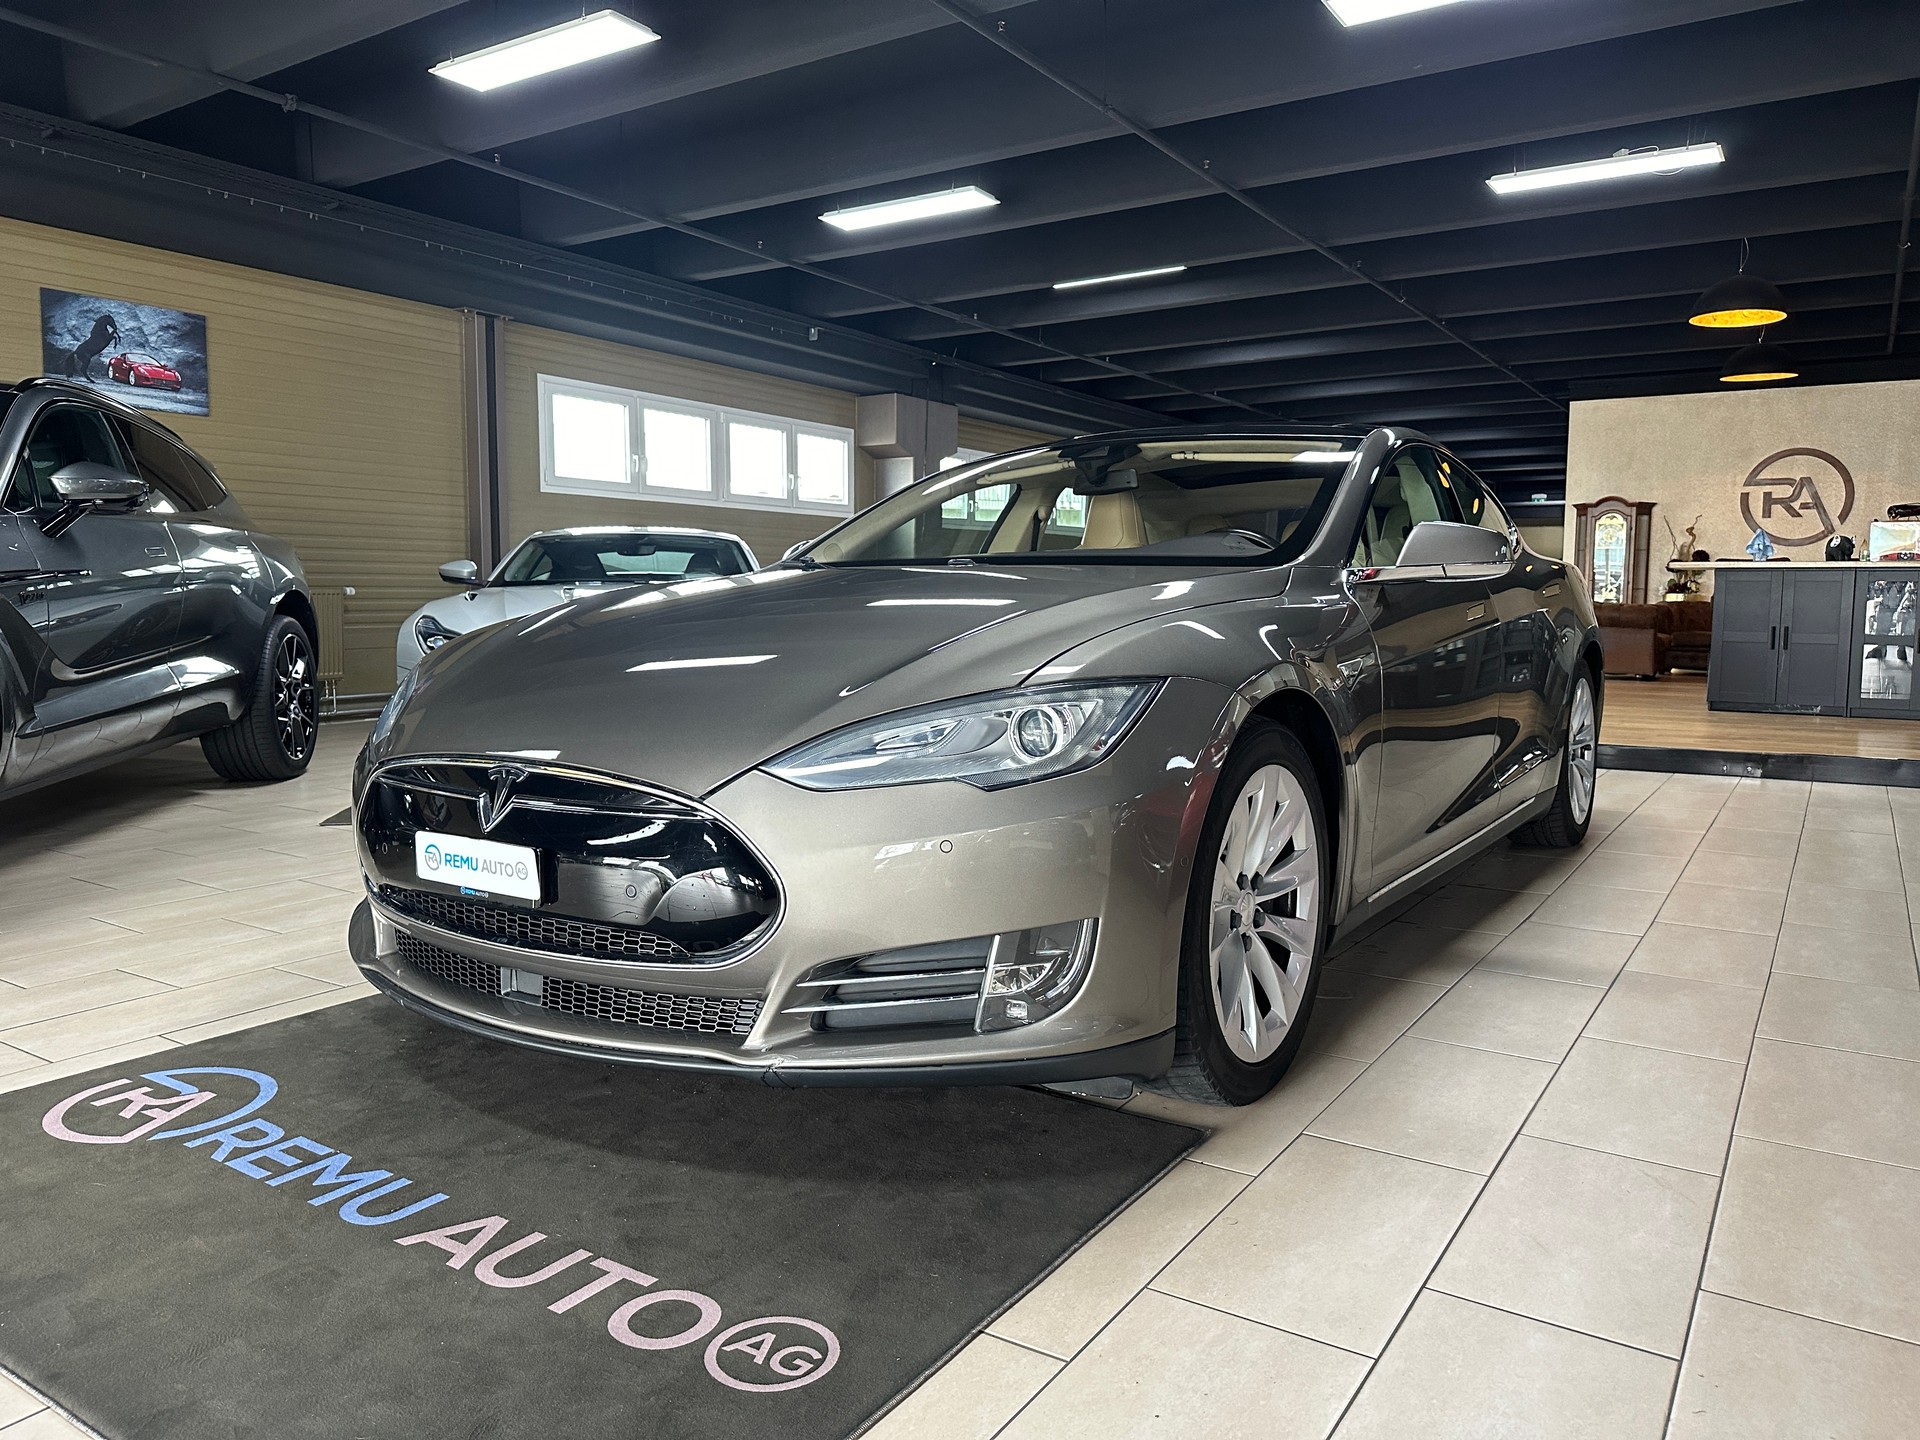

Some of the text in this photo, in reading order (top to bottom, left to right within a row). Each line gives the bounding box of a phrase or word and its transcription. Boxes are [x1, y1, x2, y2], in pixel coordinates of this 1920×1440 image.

[444, 852, 479, 871] REMU
[481, 859, 514, 877] AUTO
[183, 1117, 450, 1226] REMU
[393, 1215, 722, 1350] AUTO
[721, 1331, 823, 1377] AG
